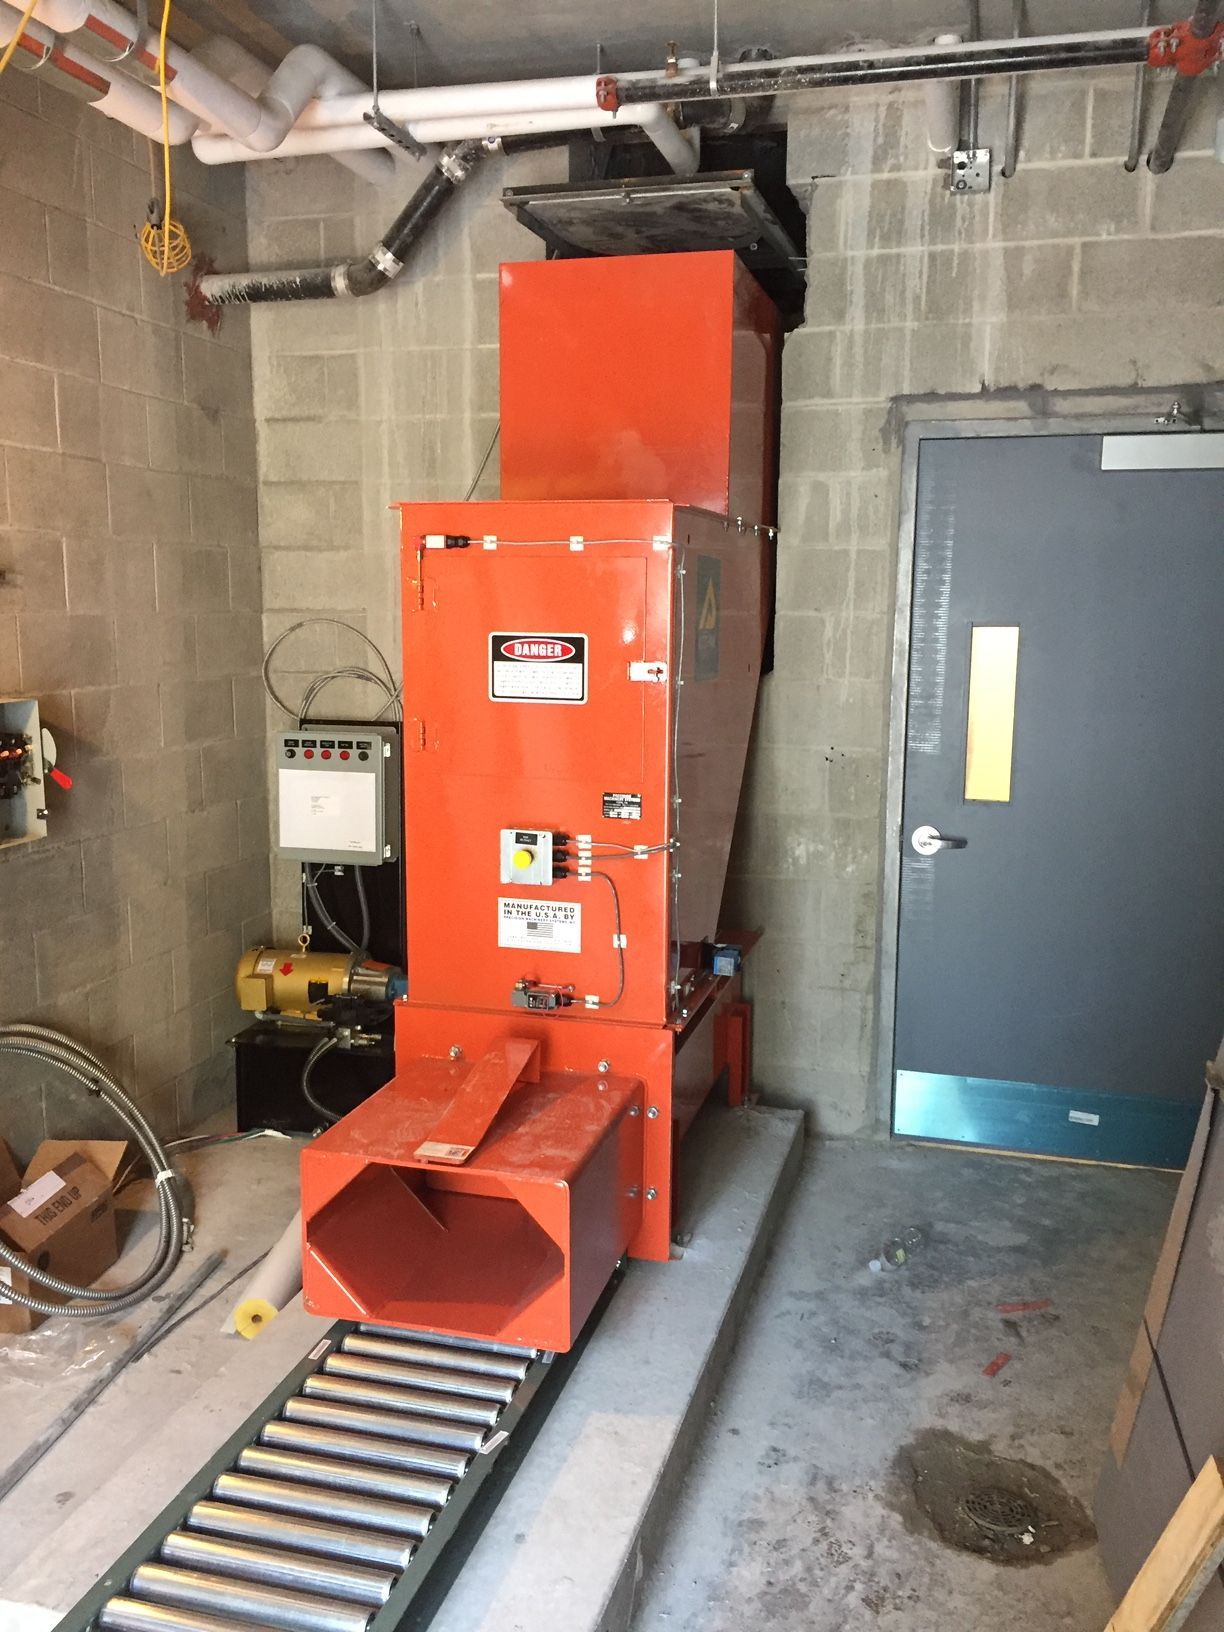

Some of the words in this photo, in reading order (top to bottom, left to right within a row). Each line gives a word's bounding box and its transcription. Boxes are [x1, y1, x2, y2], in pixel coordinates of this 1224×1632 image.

[514, 643, 562, 656] DANGER
[503, 902, 575, 913] MANUFACTURED
[535, 911, 561, 919] U.S.A.
[34, 1208, 58, 1226] THIS
[51, 1195, 73, 1213] END
[67, 1186, 82, 1202] UP
